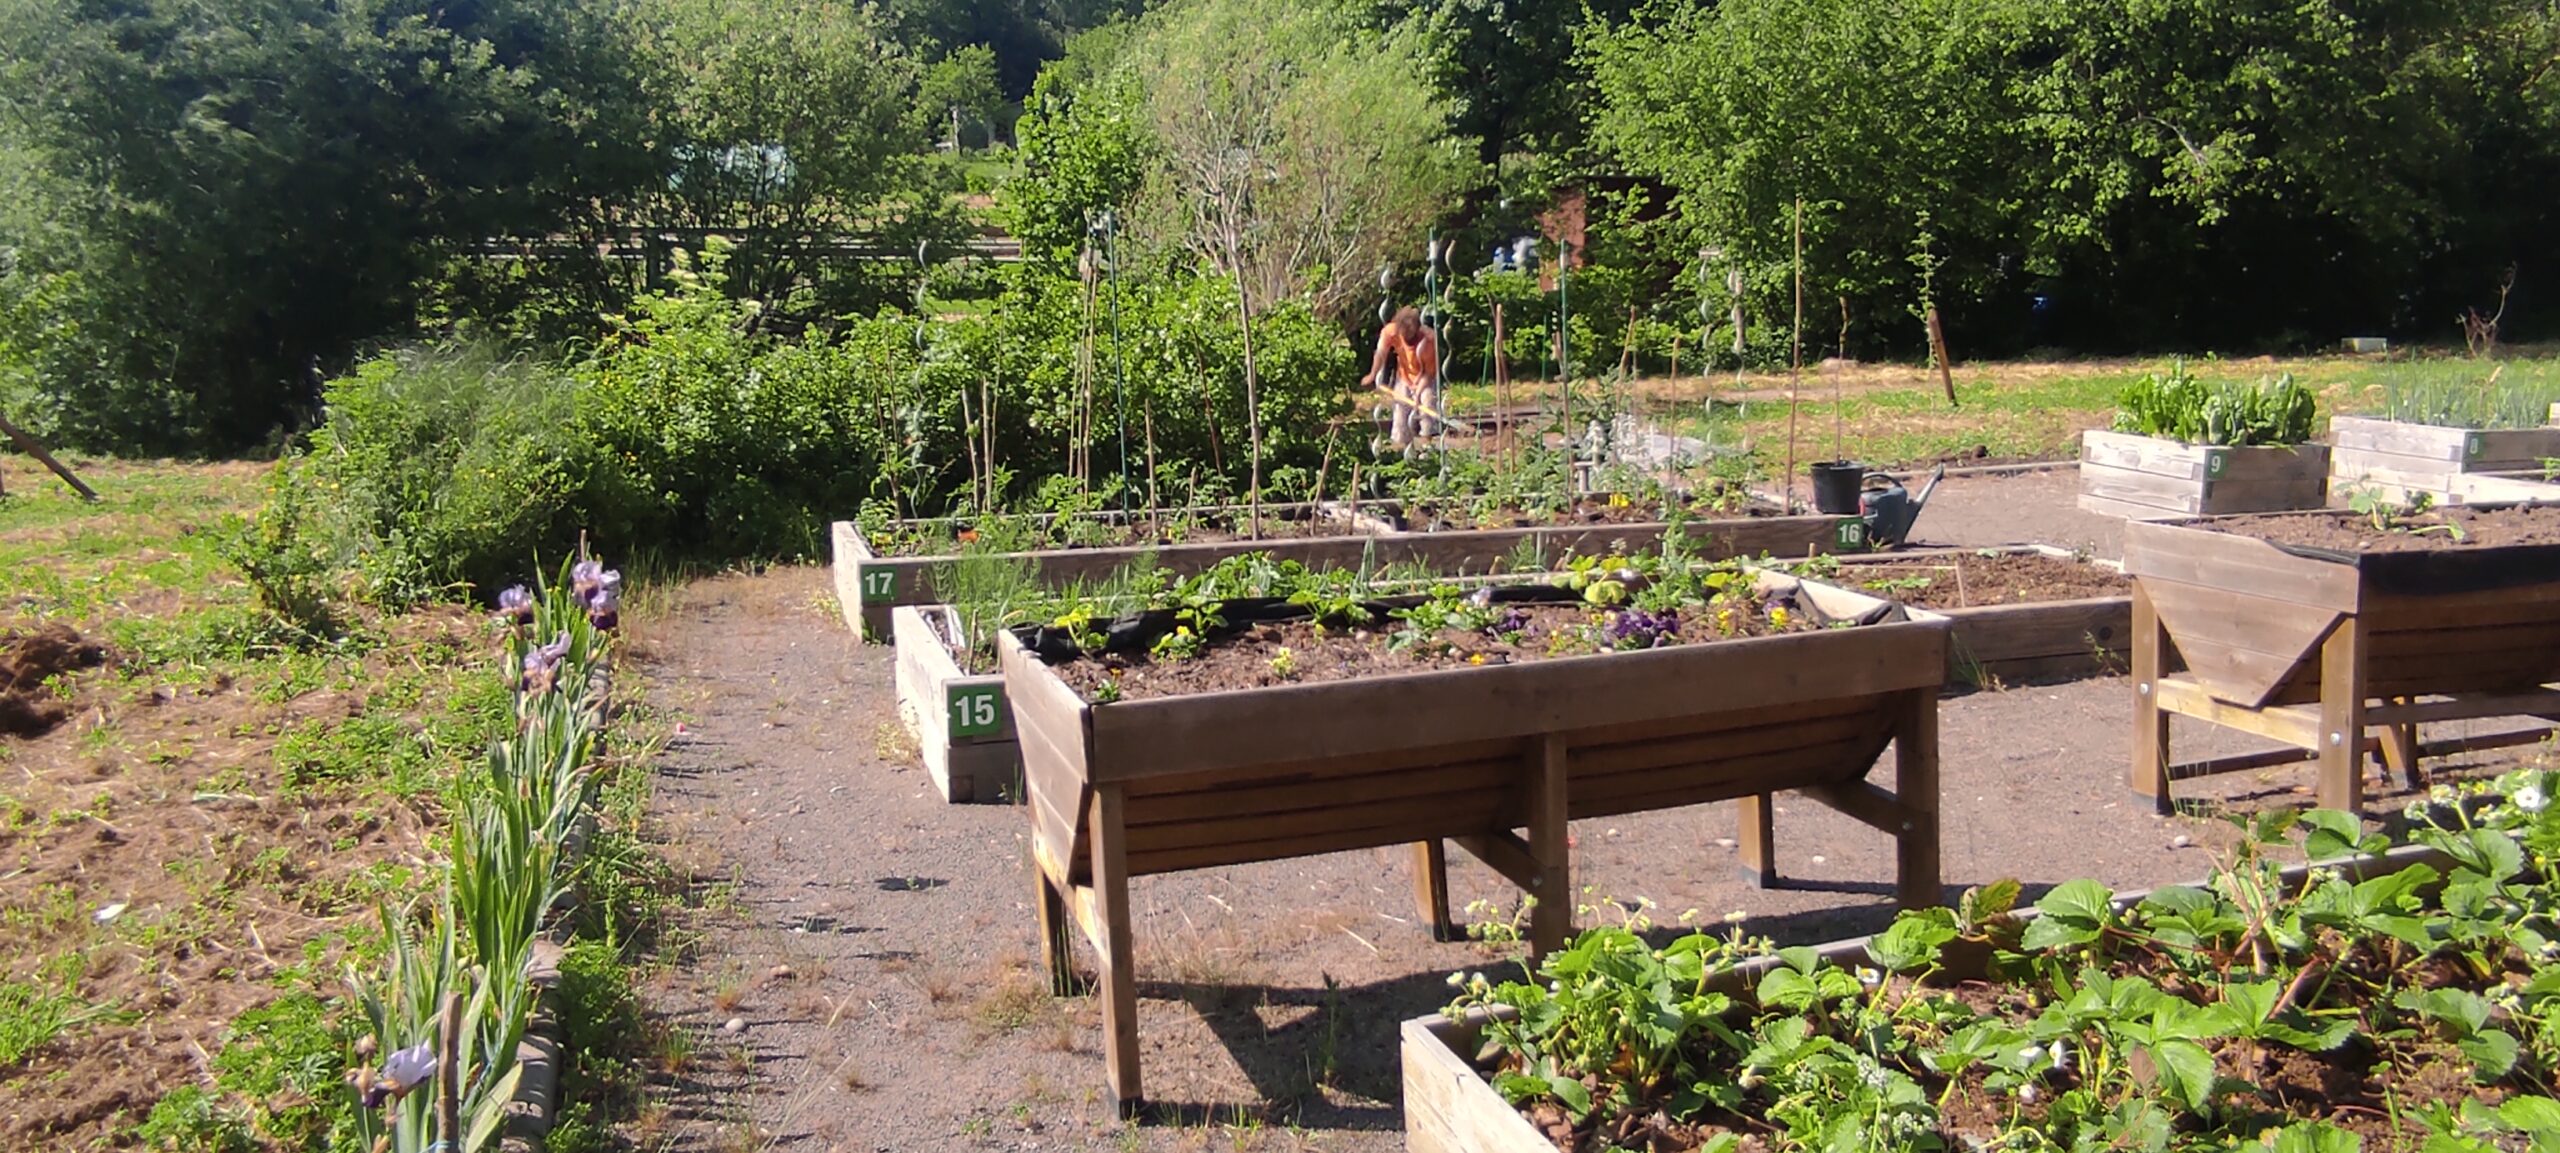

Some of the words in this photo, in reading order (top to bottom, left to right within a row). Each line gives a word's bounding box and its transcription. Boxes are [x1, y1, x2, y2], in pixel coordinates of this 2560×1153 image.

[2211, 455, 2221, 473] 9
[1839, 523, 1860, 543] 16
[864, 572, 894, 595] 17
[954, 694, 996, 727] 15
